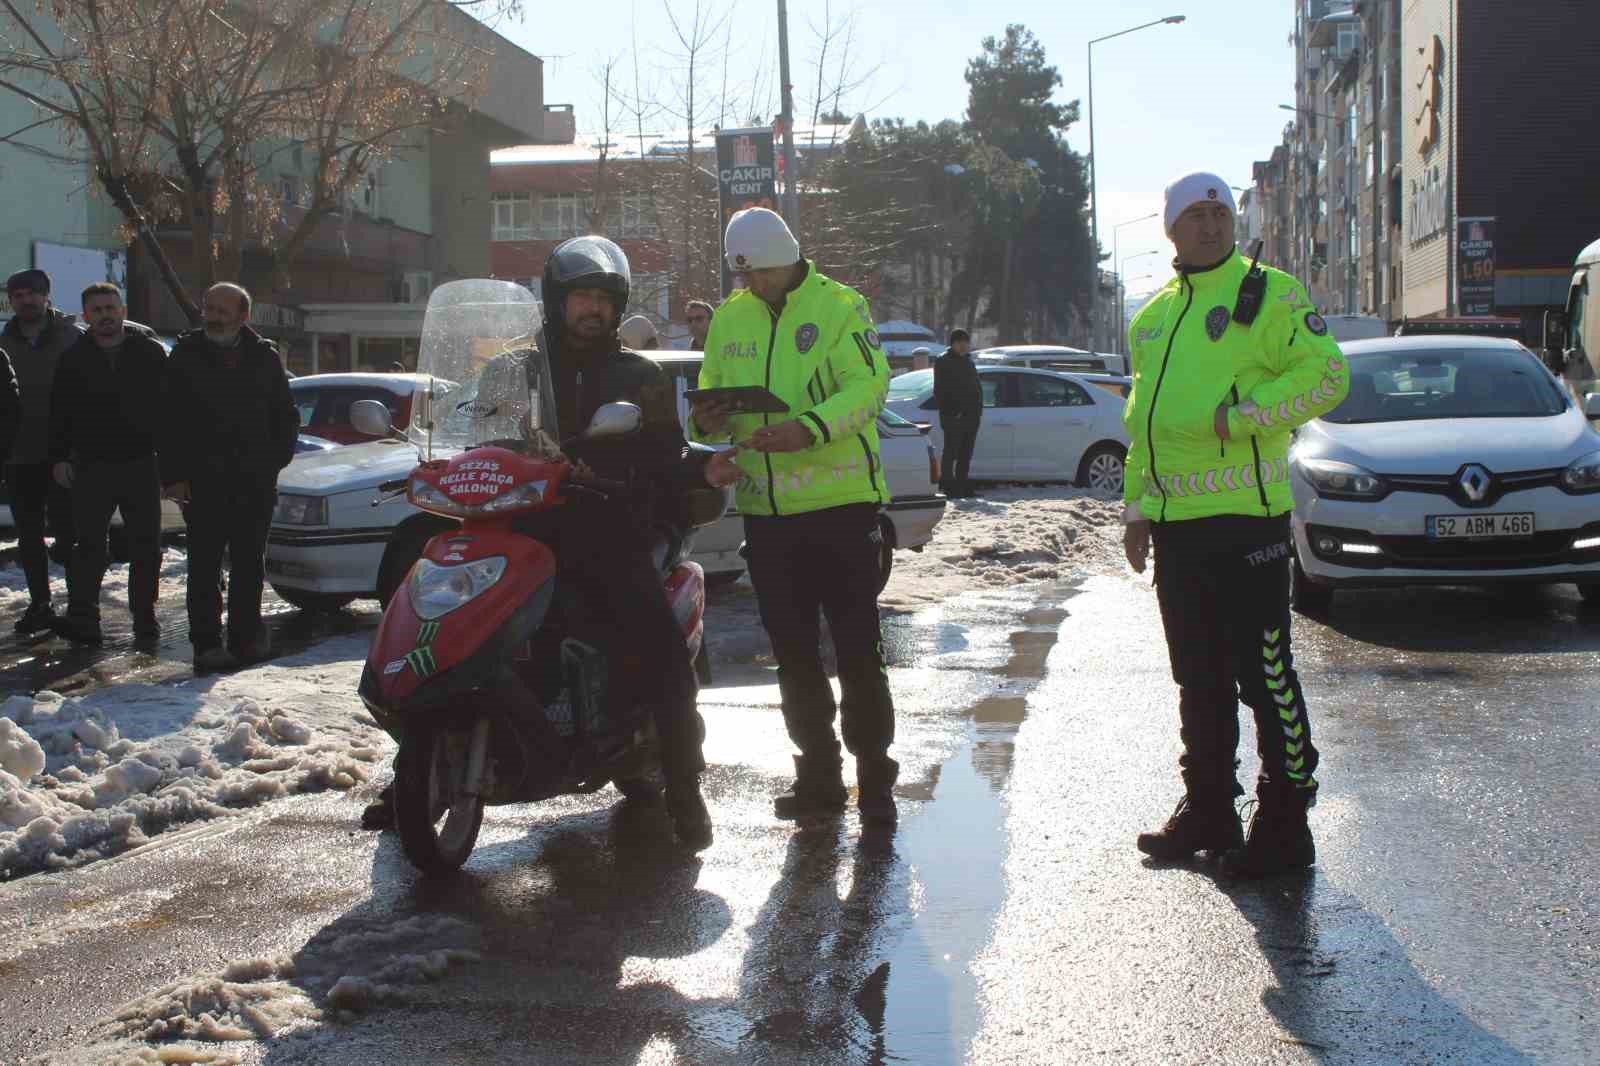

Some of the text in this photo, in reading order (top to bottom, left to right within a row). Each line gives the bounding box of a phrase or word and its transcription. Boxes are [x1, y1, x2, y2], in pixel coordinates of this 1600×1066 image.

[730, 183, 762, 194] KENT
[1438, 518, 1456, 536] 52
[1465, 517, 1496, 534] ABM
[1501, 516, 1530, 534] 466
